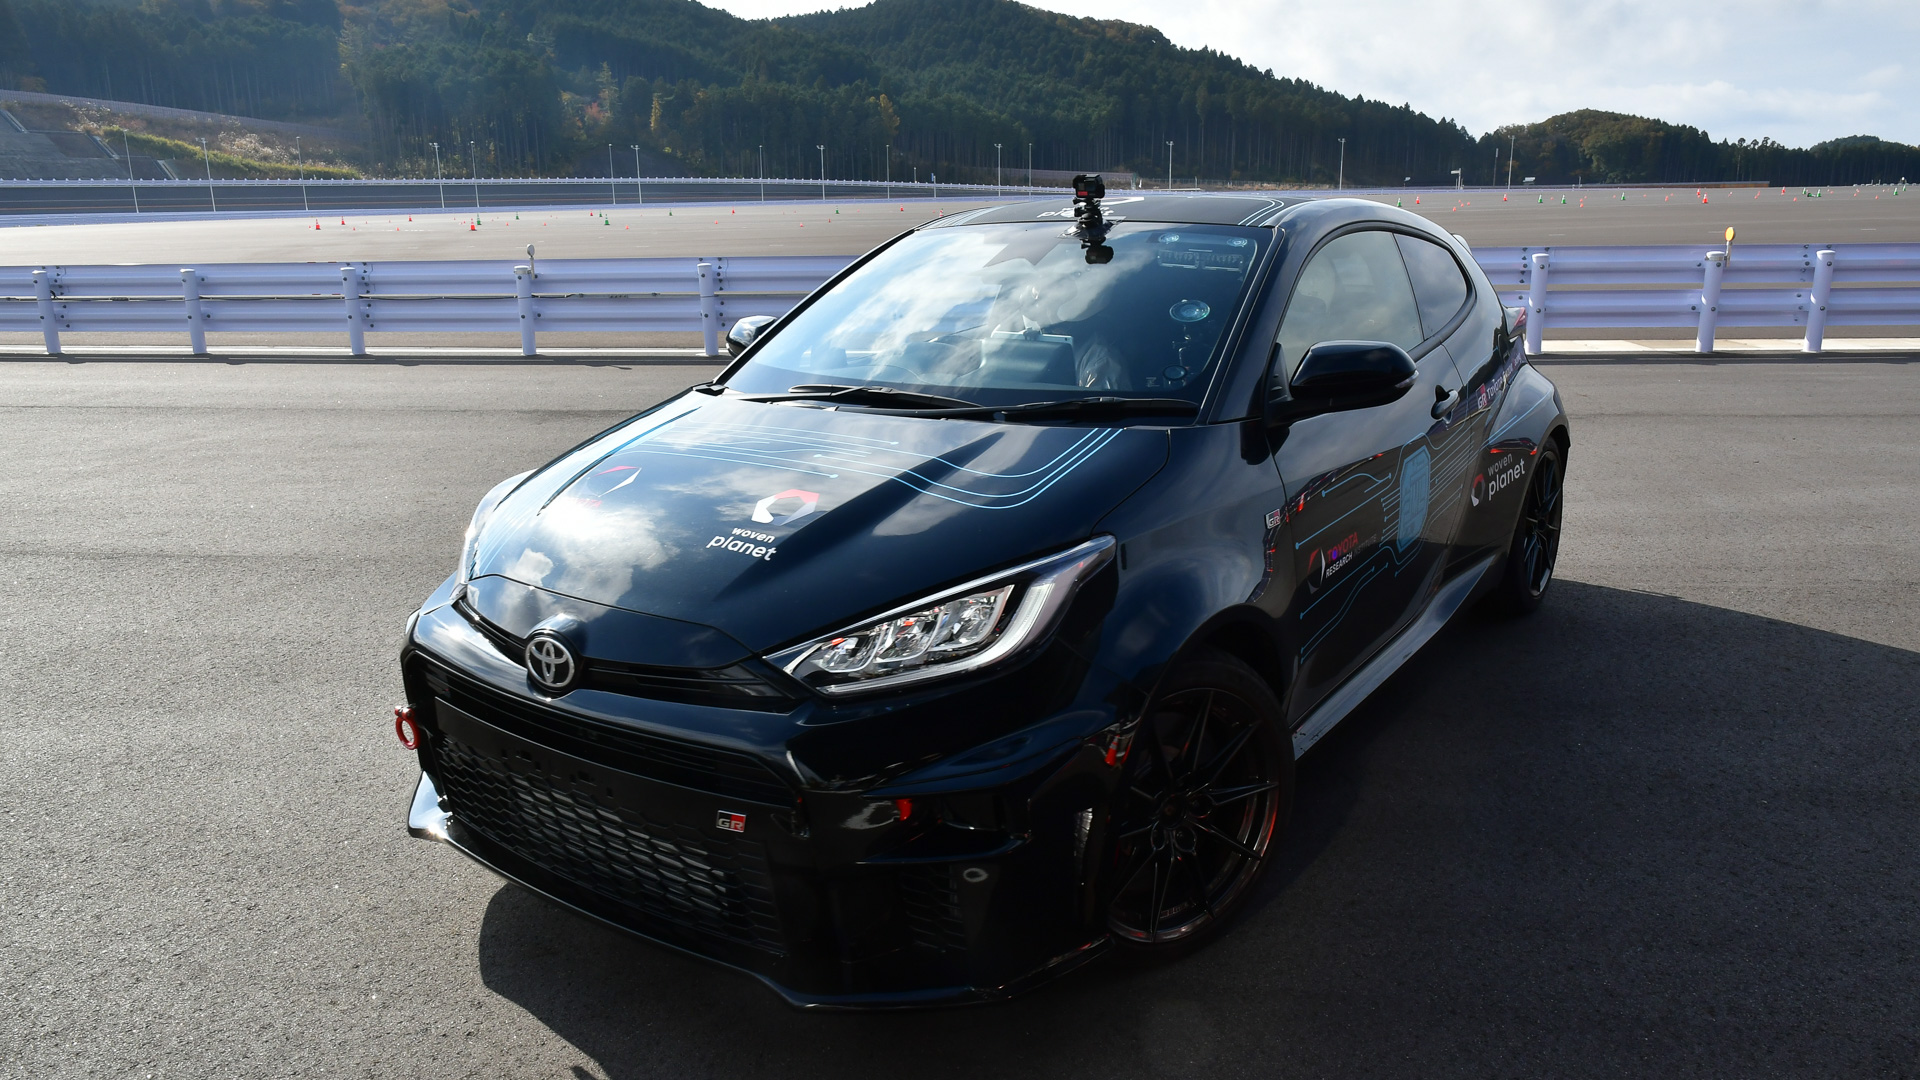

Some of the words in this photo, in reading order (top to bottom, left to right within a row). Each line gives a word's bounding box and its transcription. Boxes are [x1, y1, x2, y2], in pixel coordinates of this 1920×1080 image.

[1488, 453, 1513, 477] woven
[1489, 459, 1526, 501] planet
[706, 535, 777, 561] planet
[731, 527, 776, 543] woven
[1328, 532, 1359, 563] TOYOTA
[1326, 551, 1353, 578] RESEARCH
[718, 818, 744, 830] GR
